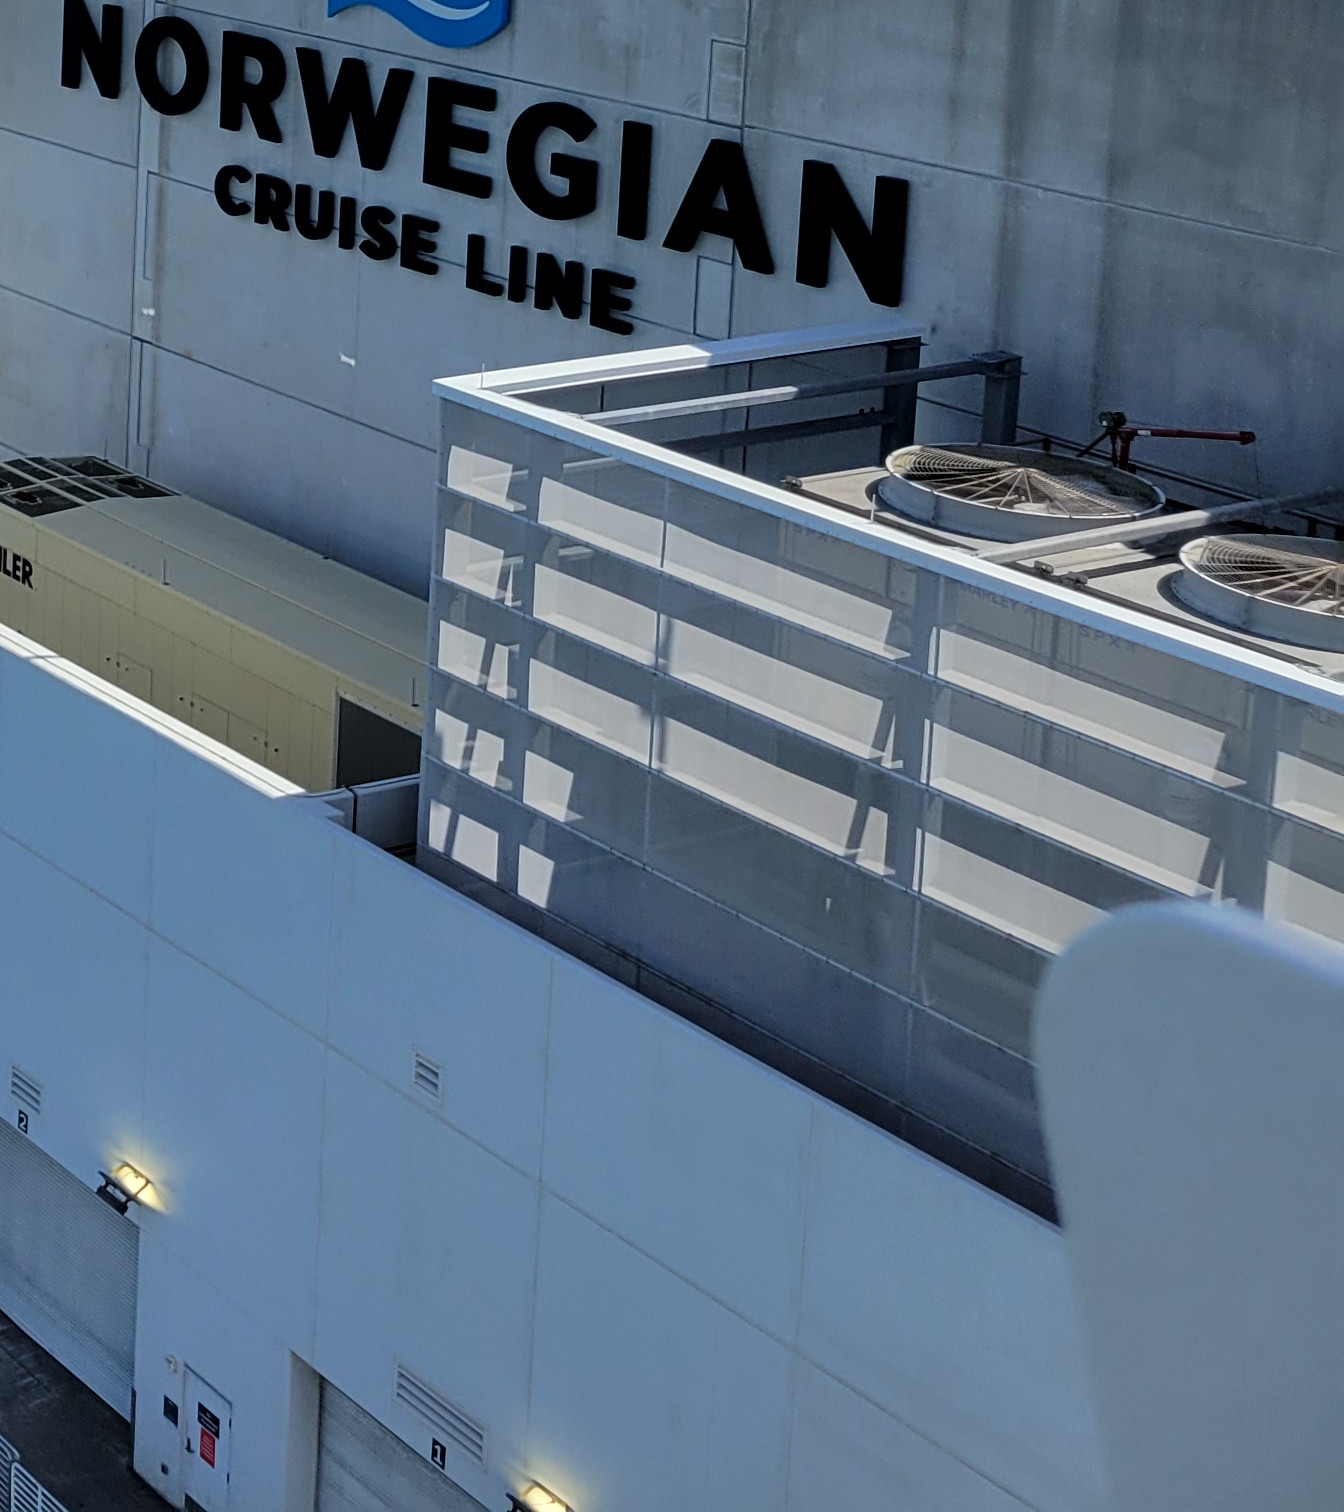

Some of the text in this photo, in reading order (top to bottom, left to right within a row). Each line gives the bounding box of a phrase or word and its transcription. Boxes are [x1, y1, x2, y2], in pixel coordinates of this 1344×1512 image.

[213, 163, 637, 335] CRUISE LINE
[19, 1113, 27, 1131] 2
[433, 1444, 443, 1466] 1
